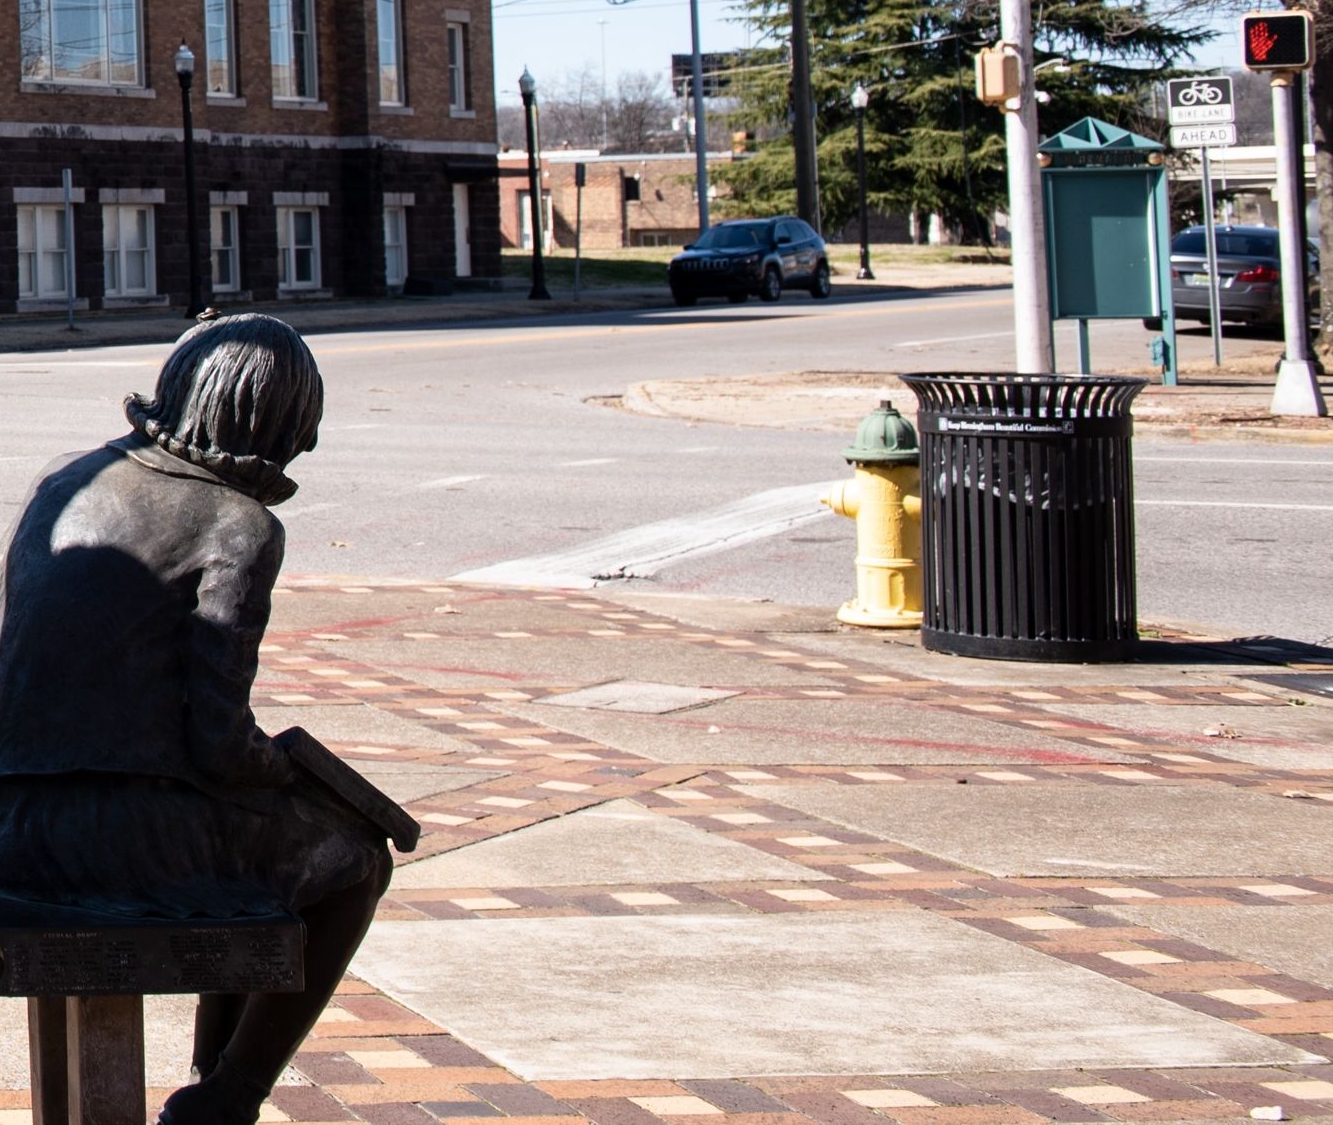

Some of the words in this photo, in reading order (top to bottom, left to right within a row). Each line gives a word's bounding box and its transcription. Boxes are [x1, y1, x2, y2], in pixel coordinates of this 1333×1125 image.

[1178, 109, 1198, 119] BIKE
[1202, 107, 1225, 118] LANE
[1181, 129, 1227, 142] AHEAD
